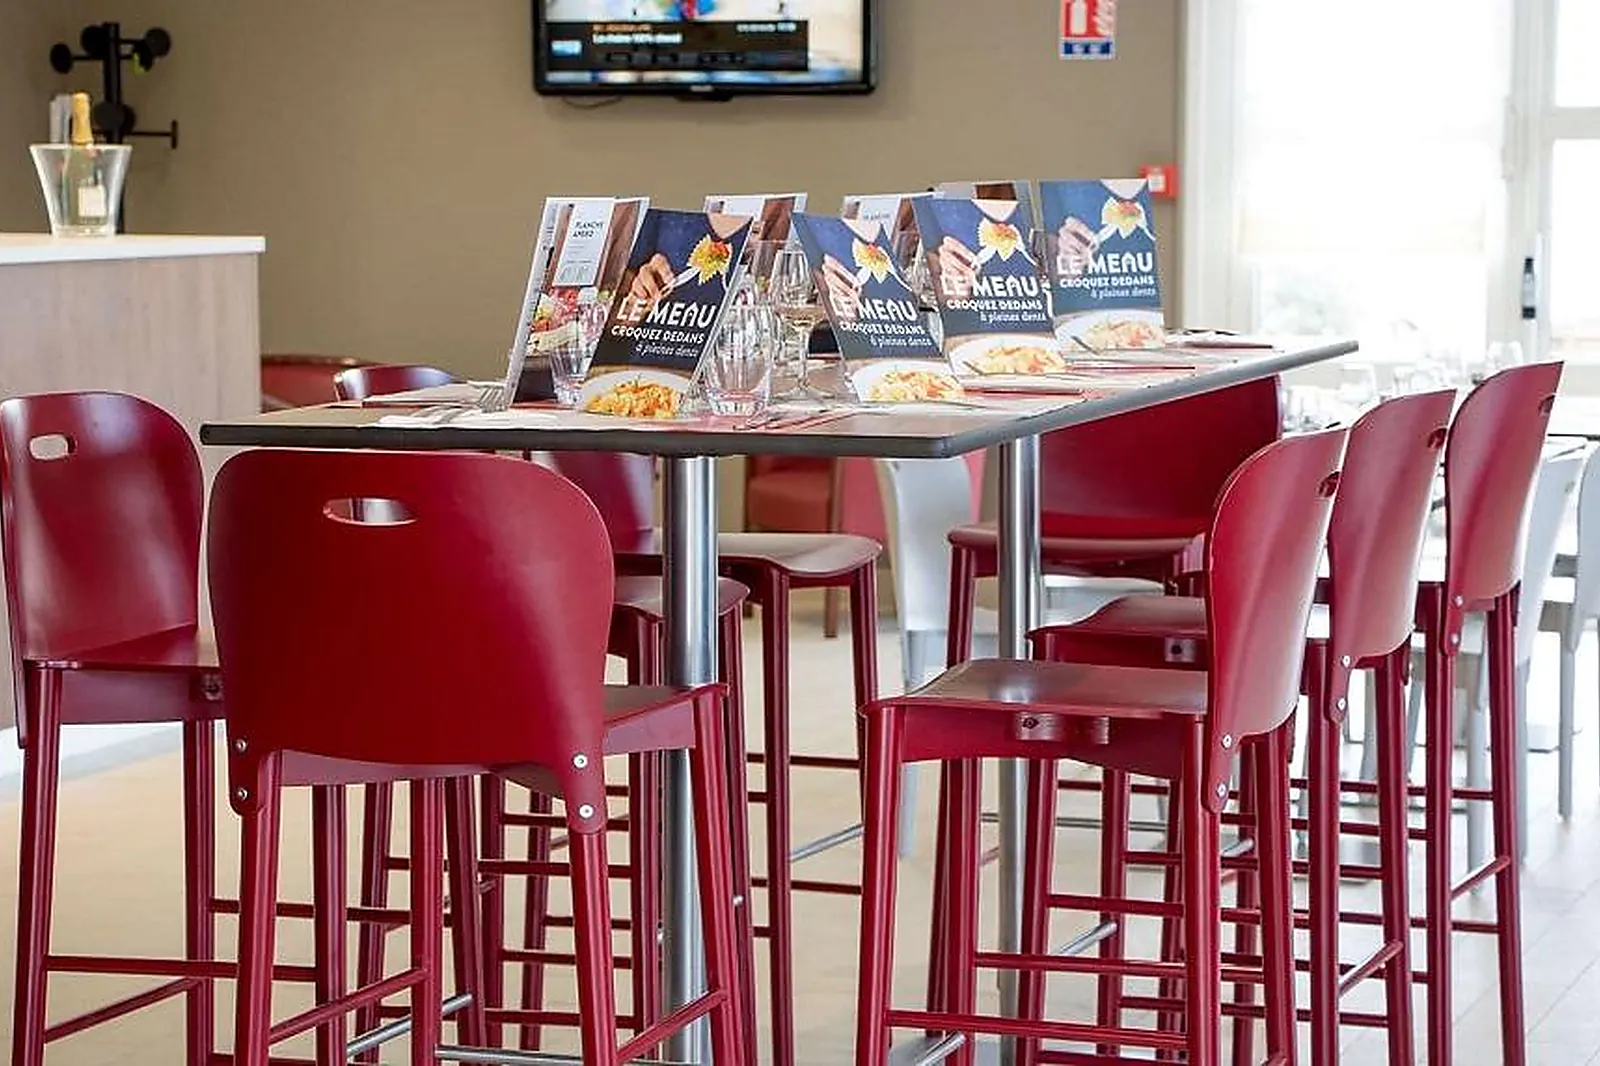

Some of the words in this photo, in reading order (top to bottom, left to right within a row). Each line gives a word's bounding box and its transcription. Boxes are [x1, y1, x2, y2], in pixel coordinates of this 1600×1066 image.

[1057, 255, 1082, 274] LE
[940, 275, 970, 295] LE
[1060, 277, 1109, 289] CROQUEZ
[1110, 275, 1155, 287] DEDANS
[616, 295, 647, 321] LE
[829, 295, 856, 318] LE
[946, 300, 998, 311] CROQUEZ
[998, 300, 1043, 310] DEDANS
[611, 325, 662, 340] CROQUEZ
[663, 331, 705, 344] DEDANS
[839, 320, 884, 335] CROQUEZ
[884, 323, 925, 335] DEDANS
